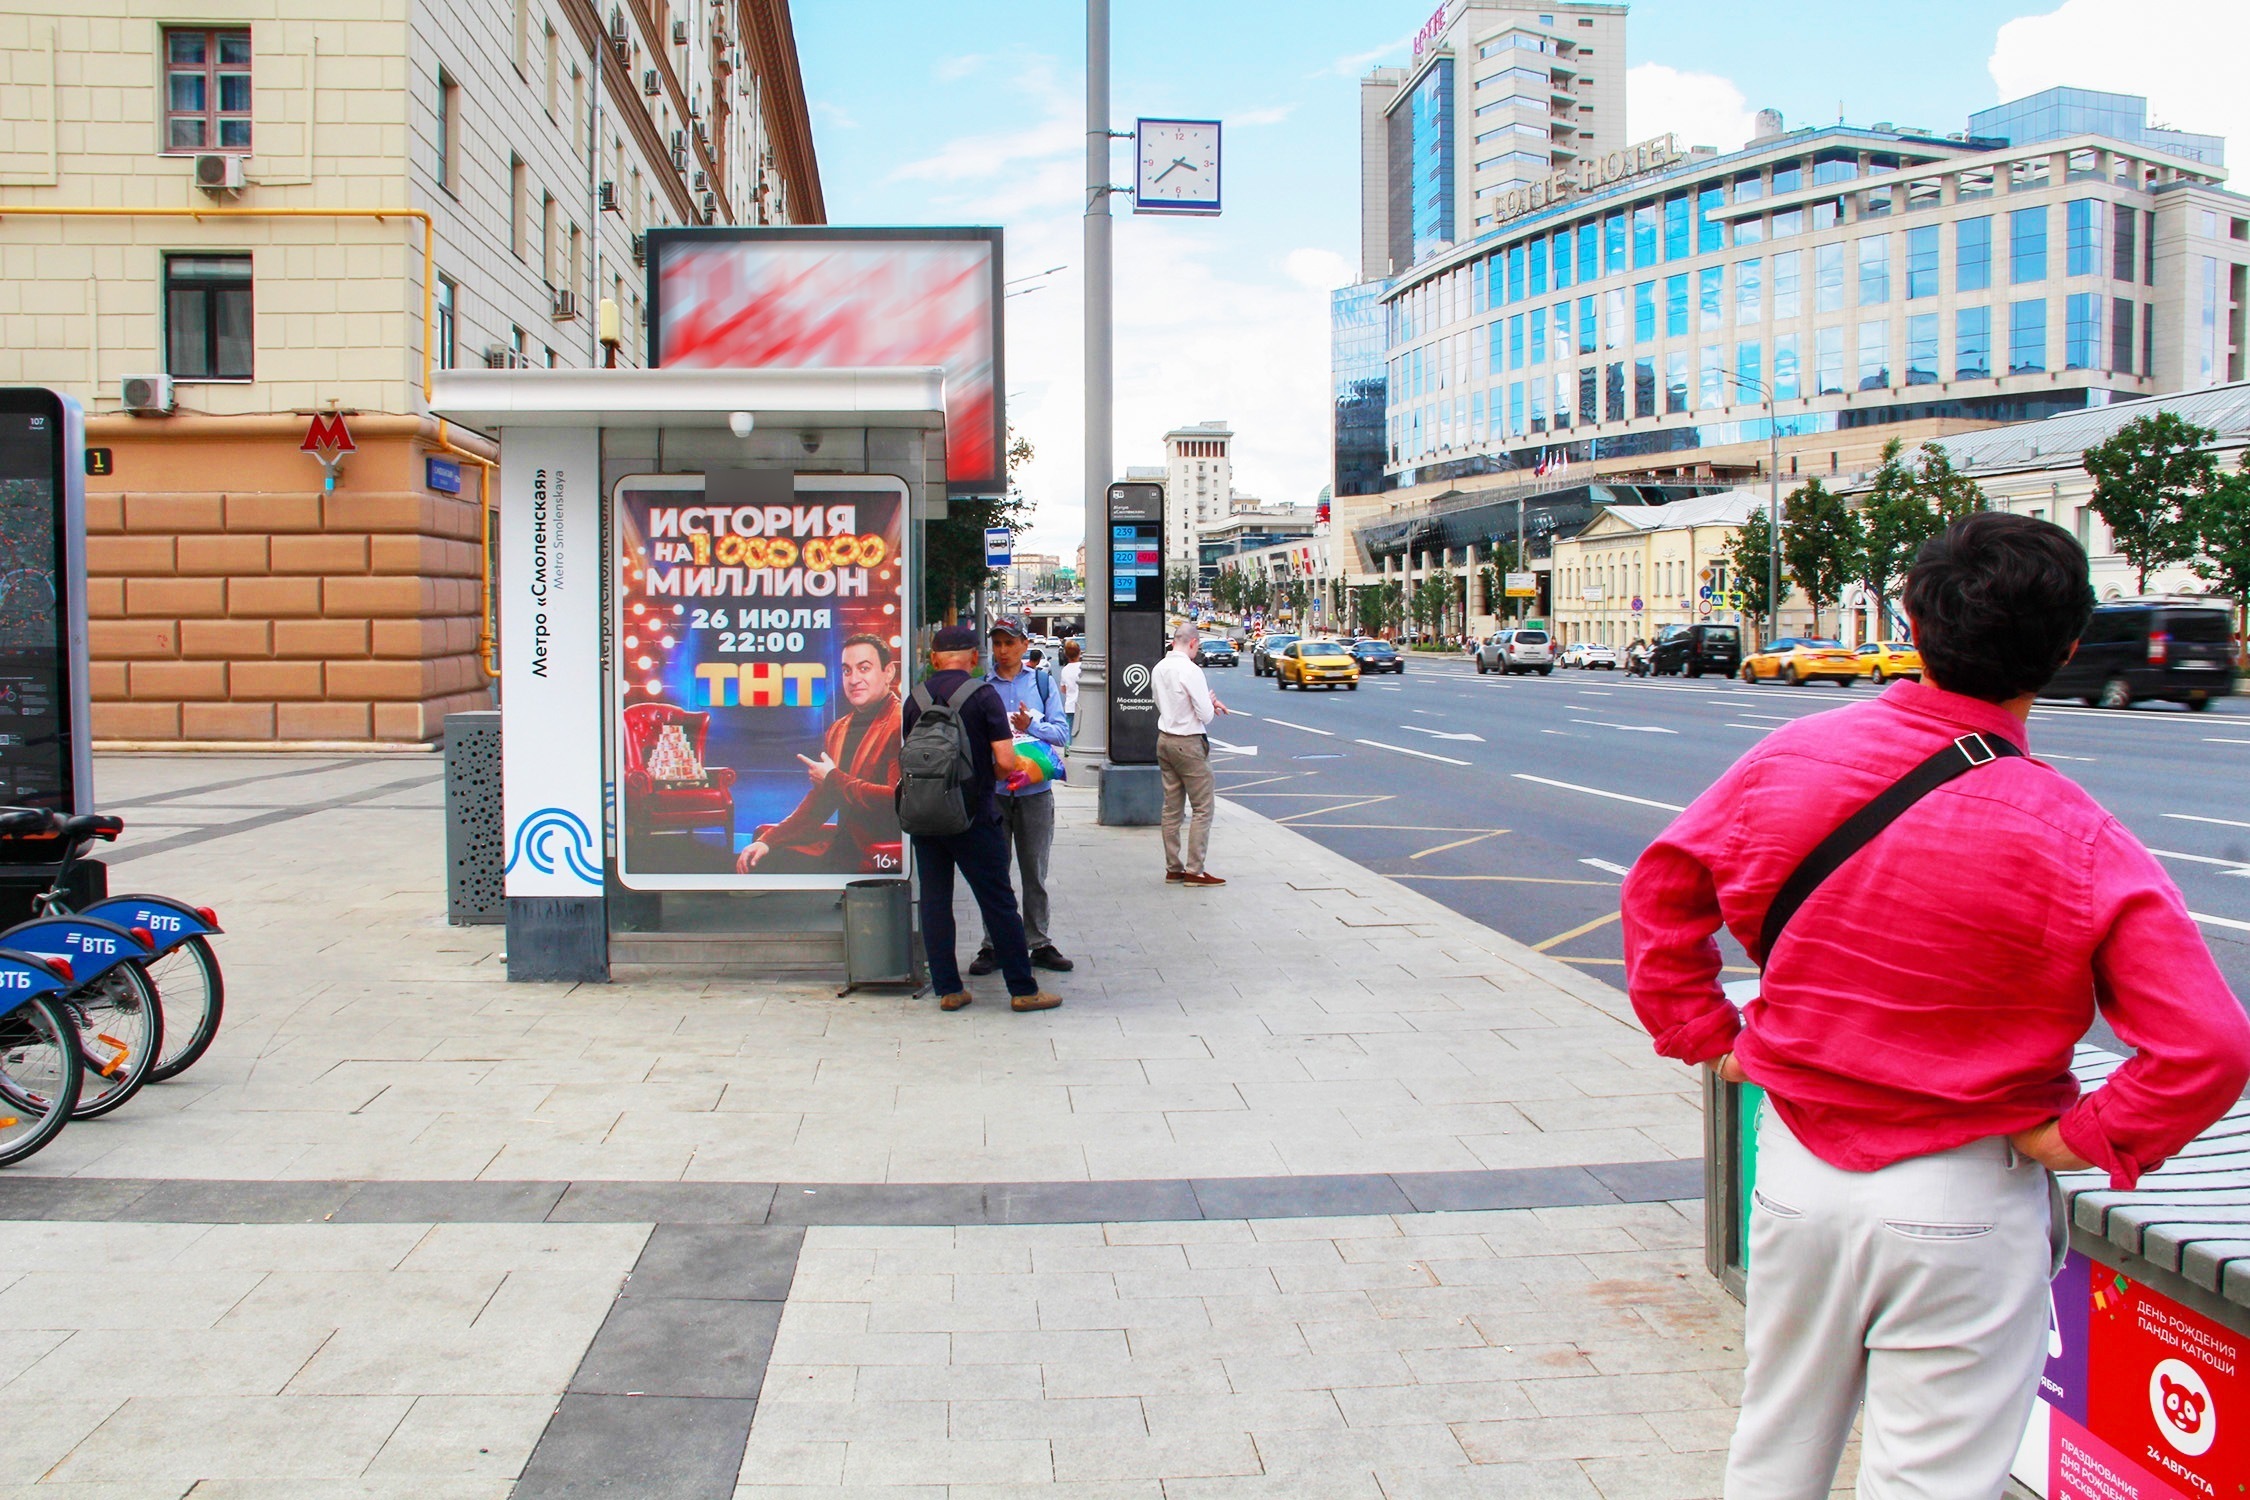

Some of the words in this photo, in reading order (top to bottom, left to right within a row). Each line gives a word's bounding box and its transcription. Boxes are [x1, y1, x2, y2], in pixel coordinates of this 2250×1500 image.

[1175, 132, 1185, 141] 12
[1148, 158, 1154, 167] 9
[1203, 159, 1210, 168] 3
[1493, 167, 1567, 223] LOTTE
[1581, 131, 1683, 191] HOTEL
[1175, 186, 1182, 194] 6
[30, 417, 44, 425] 107
[93, 451, 105, 468] 1
[552, 470, 566, 549] Smolenskaya
[649, 504, 856, 538] ИСТОРИЯ
[531, 468, 547, 607] «Смоленская»
[1116, 528, 1133, 536] 239
[654, 541, 693, 563] НА
[1116, 553, 1133, 562] 220
[553, 552, 565, 590] Metro
[645, 566, 869, 597] МИЛЛИОН
[1116, 578, 1133, 587] 379
[691, 608, 730, 629] 26
[738, 608, 831, 629] ИЮЛЯ
[532, 612, 550, 678] Метро
[718, 632, 805, 653] 22:00
[695, 662, 827, 708] ТНТ
[872, 854, 899, 869] 16+
[150, 914, 181, 932] ВТБ
[82, 937, 116, 955] ВТБ
[2137, 1300, 2167, 1323] ДЕНЬ
[2169, 1316, 2236, 1360] РОЖДЕНИЯ
[2138, 1316, 2179, 1347] ПАНДЫ
[2181, 1339, 2235, 1377] КАТЮШИ
[2041, 1375, 2064, 1398] ЯБРЯ
[2060, 1453, 2080, 1474] ДНЯ
[2061, 1437, 2138, 1500] ПРАЗДНОВАНИЕ
[2147, 1445, 2161, 1461] 24
[2162, 1456, 2214, 1497] АВГУСТА
